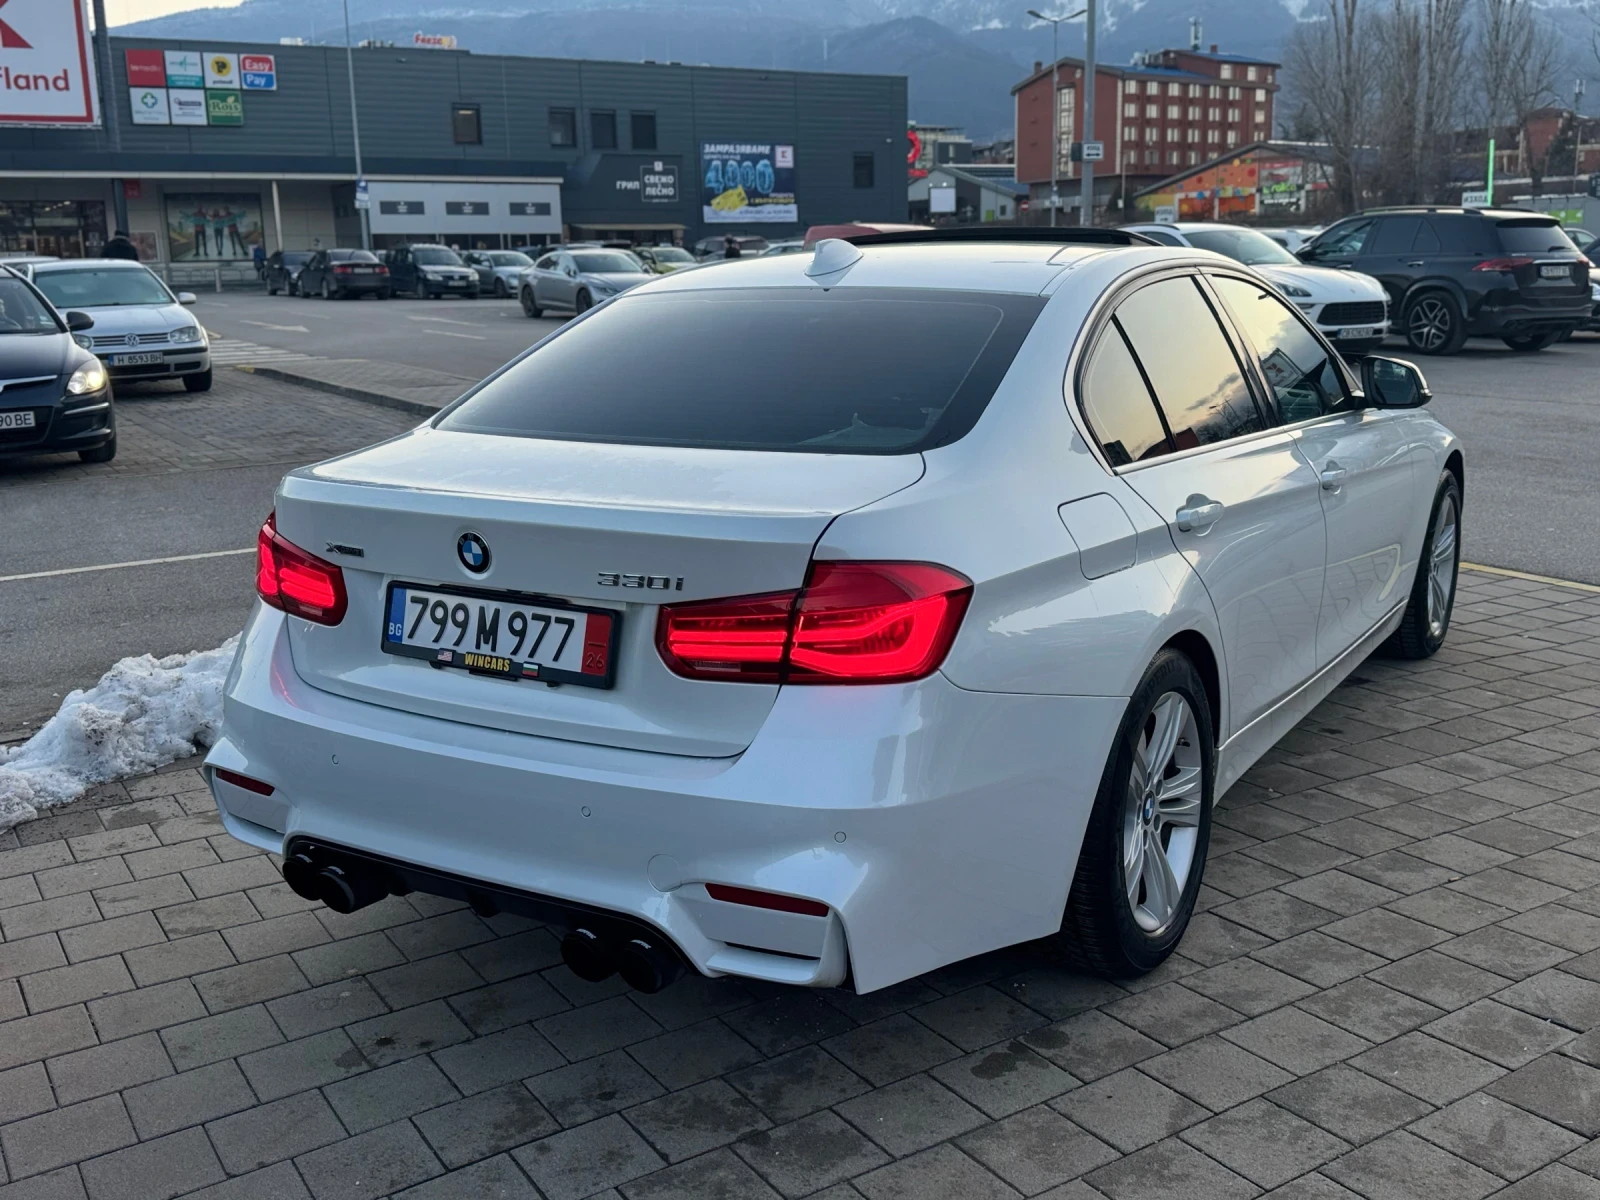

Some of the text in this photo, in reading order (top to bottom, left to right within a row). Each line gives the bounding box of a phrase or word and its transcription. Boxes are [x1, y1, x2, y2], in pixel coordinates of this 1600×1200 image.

[244, 59, 271, 72] Easy
[0, 66, 70, 92] land
[246, 74, 267, 88] Pay
[127, 354, 149, 364] 8593
[14, 413, 33, 426] BE
[597, 571, 684, 591] 330i
[388, 622, 403, 637] BG
[464, 653, 511, 672] WINCARS
[586, 651, 605, 670] 26
